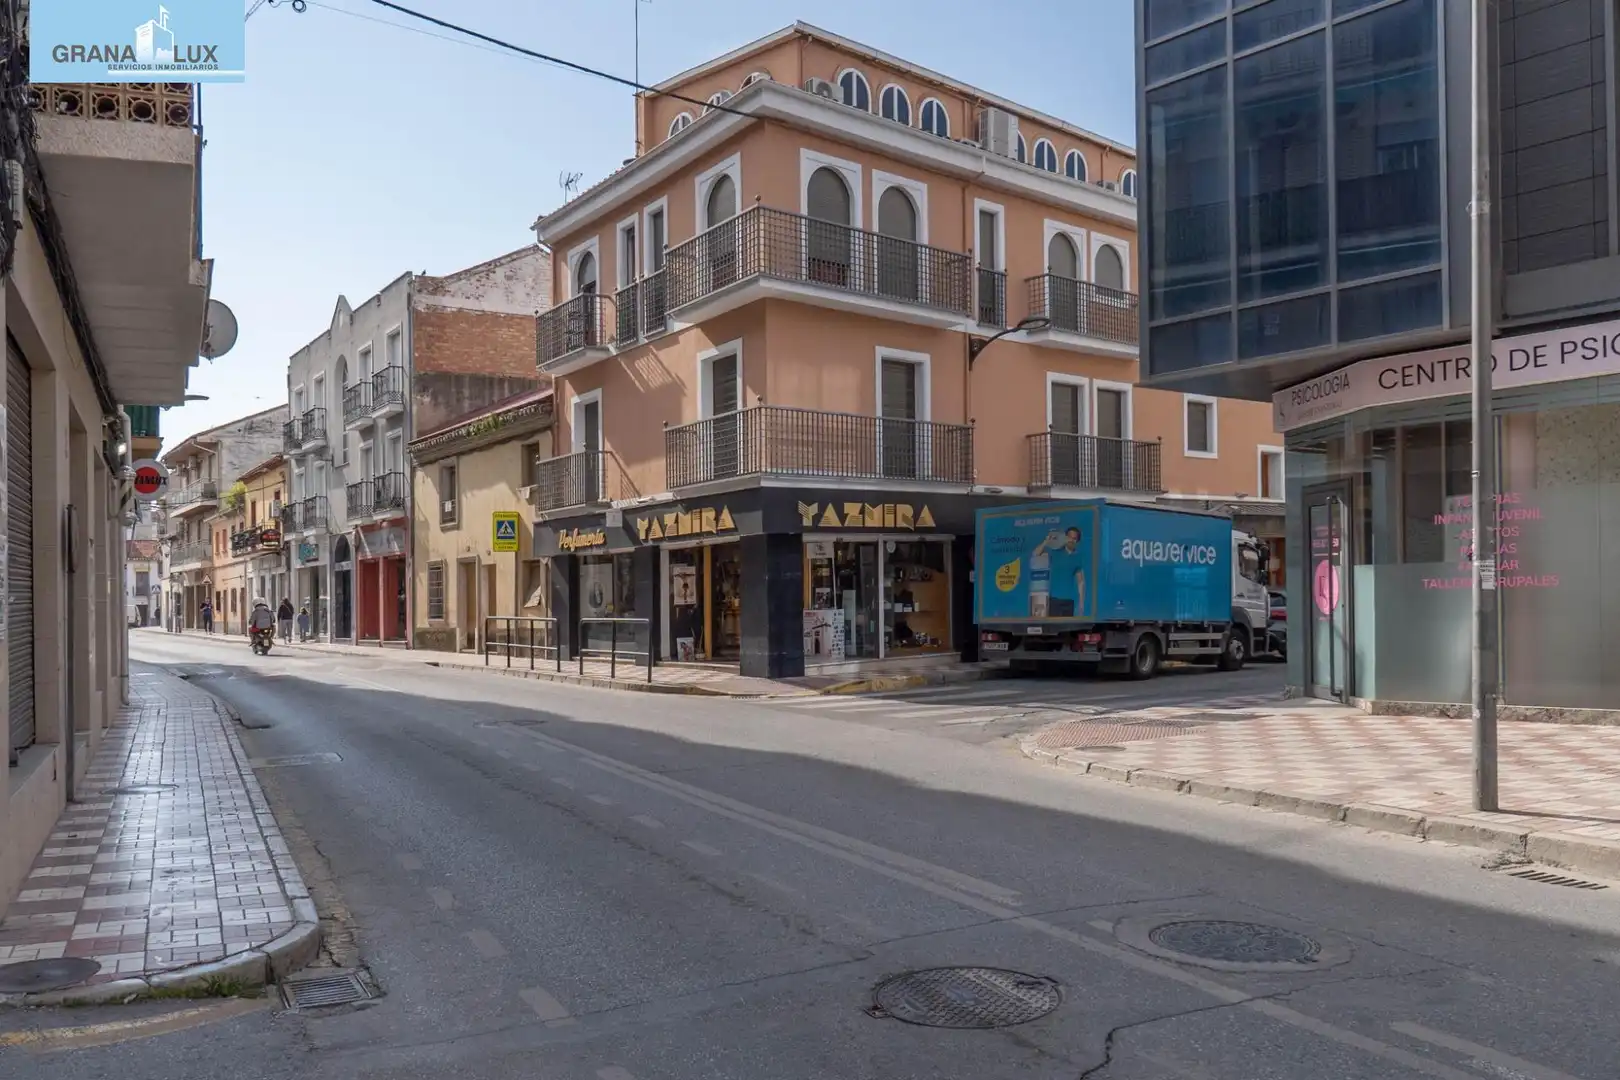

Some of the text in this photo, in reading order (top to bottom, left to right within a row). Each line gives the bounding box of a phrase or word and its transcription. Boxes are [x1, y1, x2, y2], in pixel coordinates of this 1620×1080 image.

[1509, 344, 1548, 372] DE
[636, 504, 736, 540] YAZMIRA
[798, 500, 937, 532] YAZMIRA
[1121, 538, 1218, 568] aquaservice
[1003, 565, 1010, 574] 3
